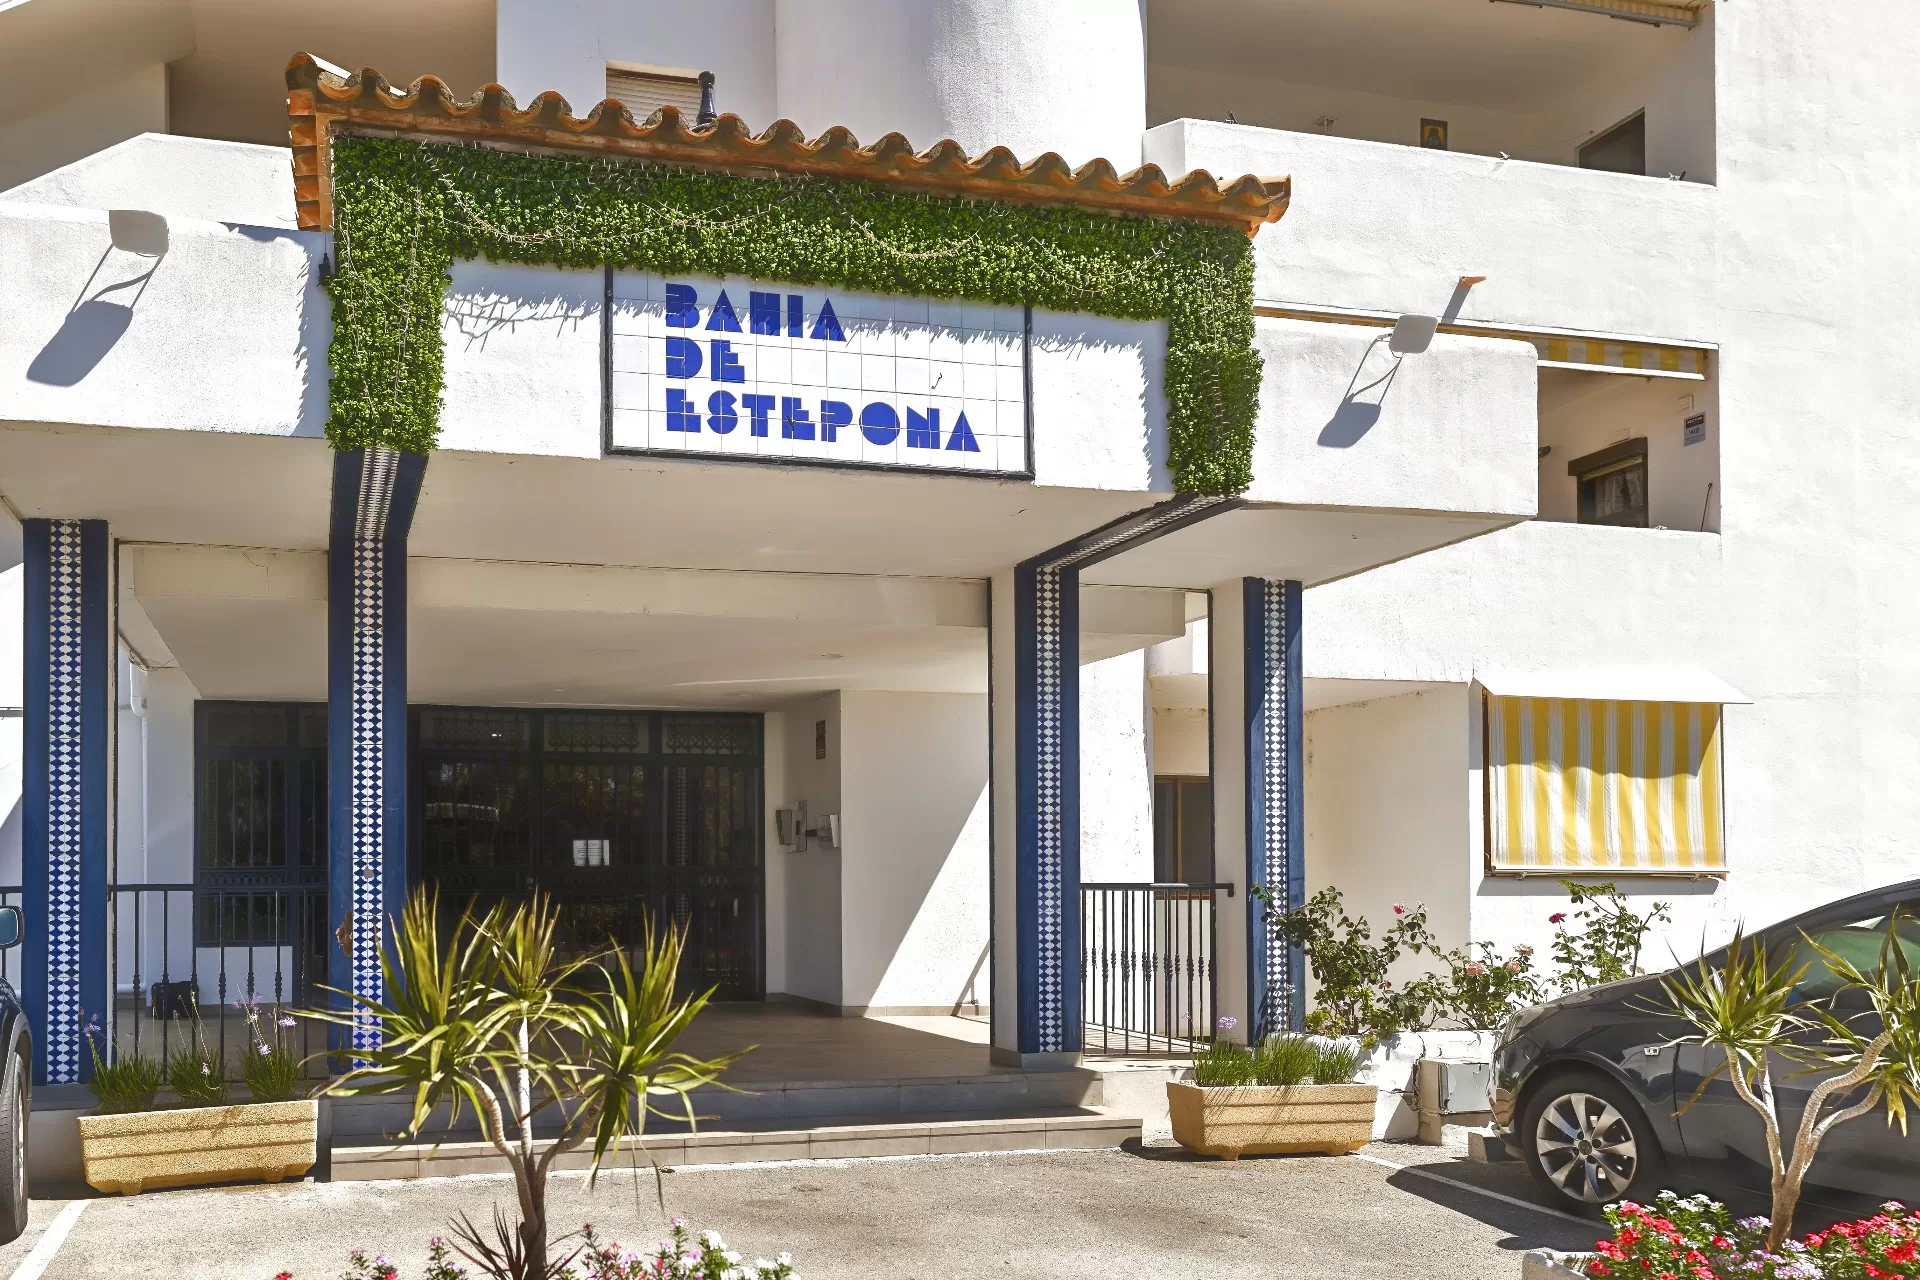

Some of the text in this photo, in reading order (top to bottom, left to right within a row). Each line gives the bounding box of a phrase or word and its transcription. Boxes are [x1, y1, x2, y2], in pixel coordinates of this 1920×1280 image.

[665, 283, 847, 342] BAHIA
[665, 335, 746, 384] DE
[665, 387, 981, 453] ESTEPONA
